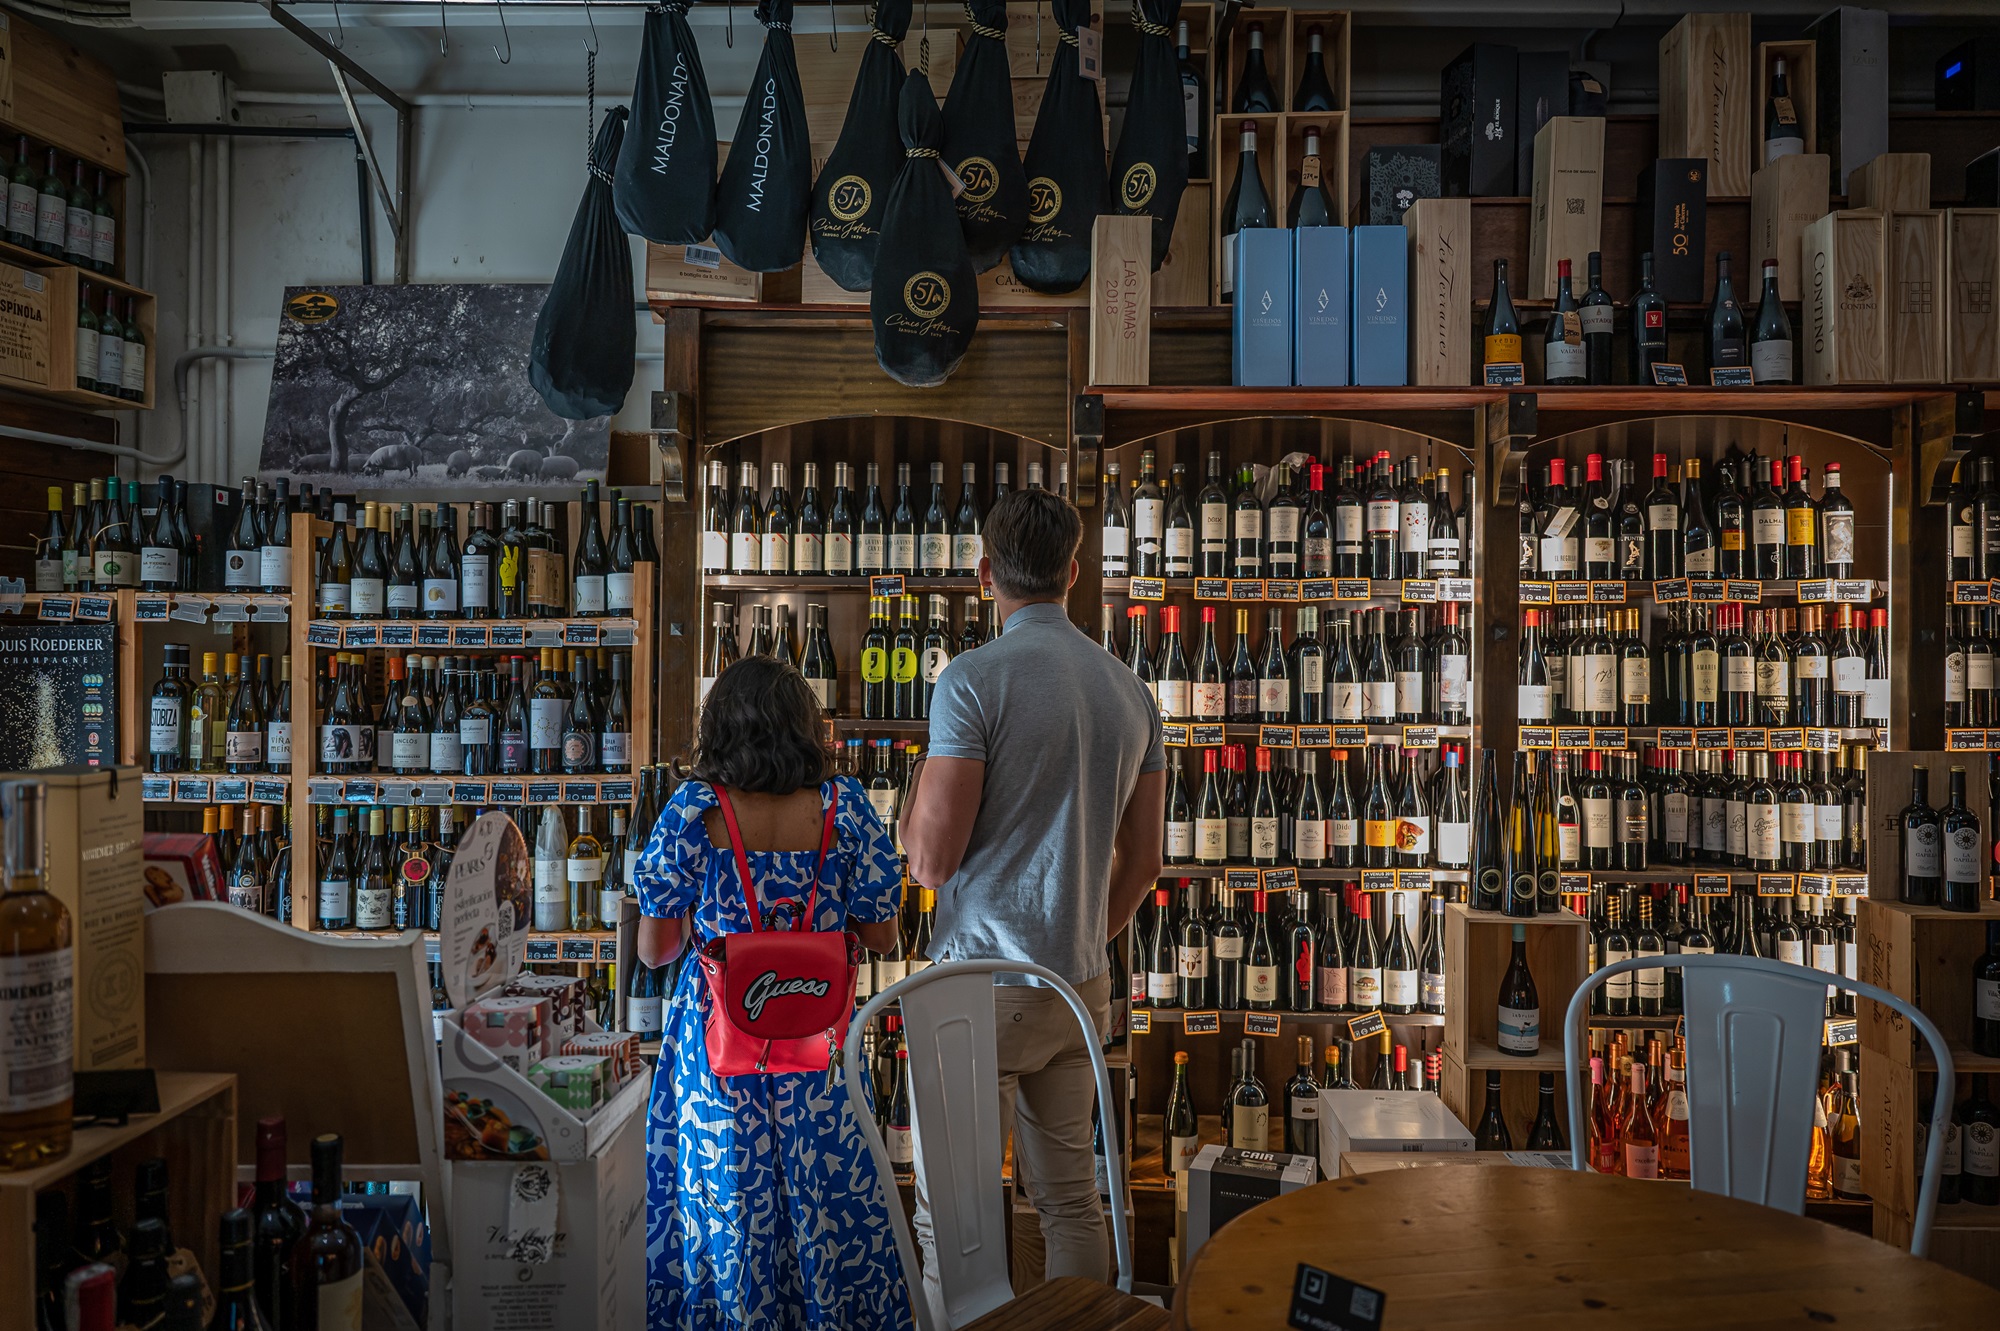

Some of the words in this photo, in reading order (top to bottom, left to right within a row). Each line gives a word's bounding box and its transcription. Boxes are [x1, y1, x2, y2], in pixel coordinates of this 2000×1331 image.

[746, 78, 776, 212] MALDONADO
[1123, 259, 1137, 288] LAS
[913, 282, 938, 307] 5J
[1106, 280, 1120, 316] 2018
[1814, 252, 1825, 354] CONTINO
[1841, 302, 1878, 311] CONTINO
[1123, 292, 1137, 340] LAMAS
[31, 638, 104, 652] ROEDERER
[4, 656, 88, 664] CHAMPAGNE
[744, 971, 829, 1021] Guess
[1241, 1149, 1275, 1161] CAIR
